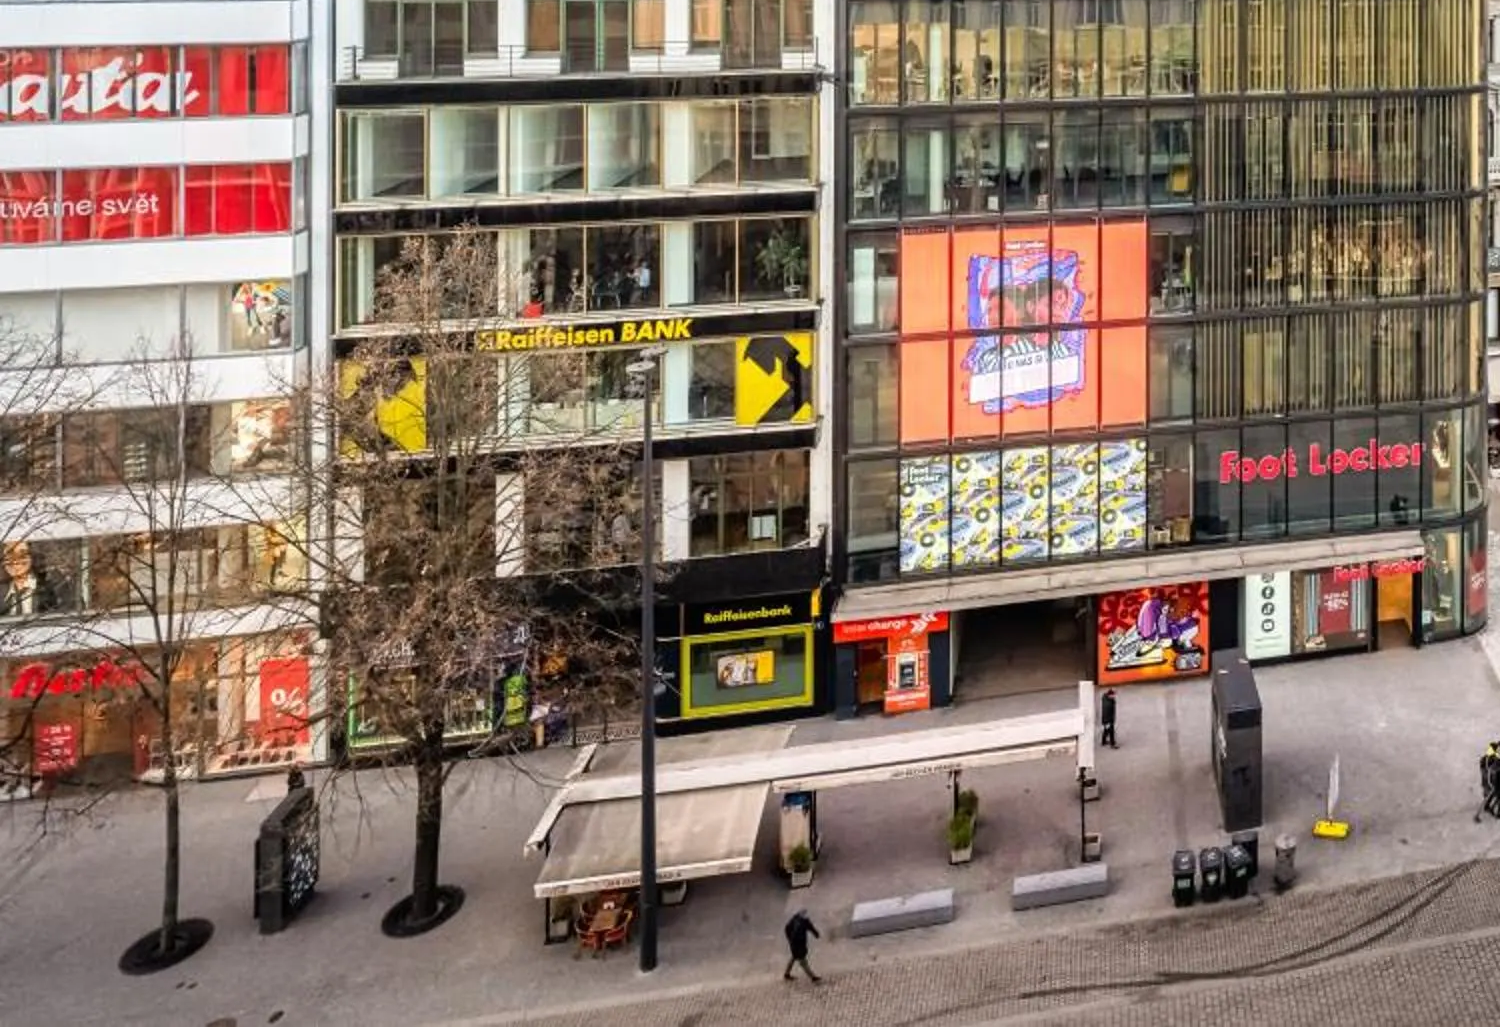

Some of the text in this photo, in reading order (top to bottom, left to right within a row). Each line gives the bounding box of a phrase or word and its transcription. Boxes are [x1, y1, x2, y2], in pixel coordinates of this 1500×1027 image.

[102, 193, 160, 216] svět
[496, 319, 693, 350] Raiffeisen BANK
[1219, 437, 1425, 484] Foot Locker
[704, 605, 793, 623] Raiffeisenbank
